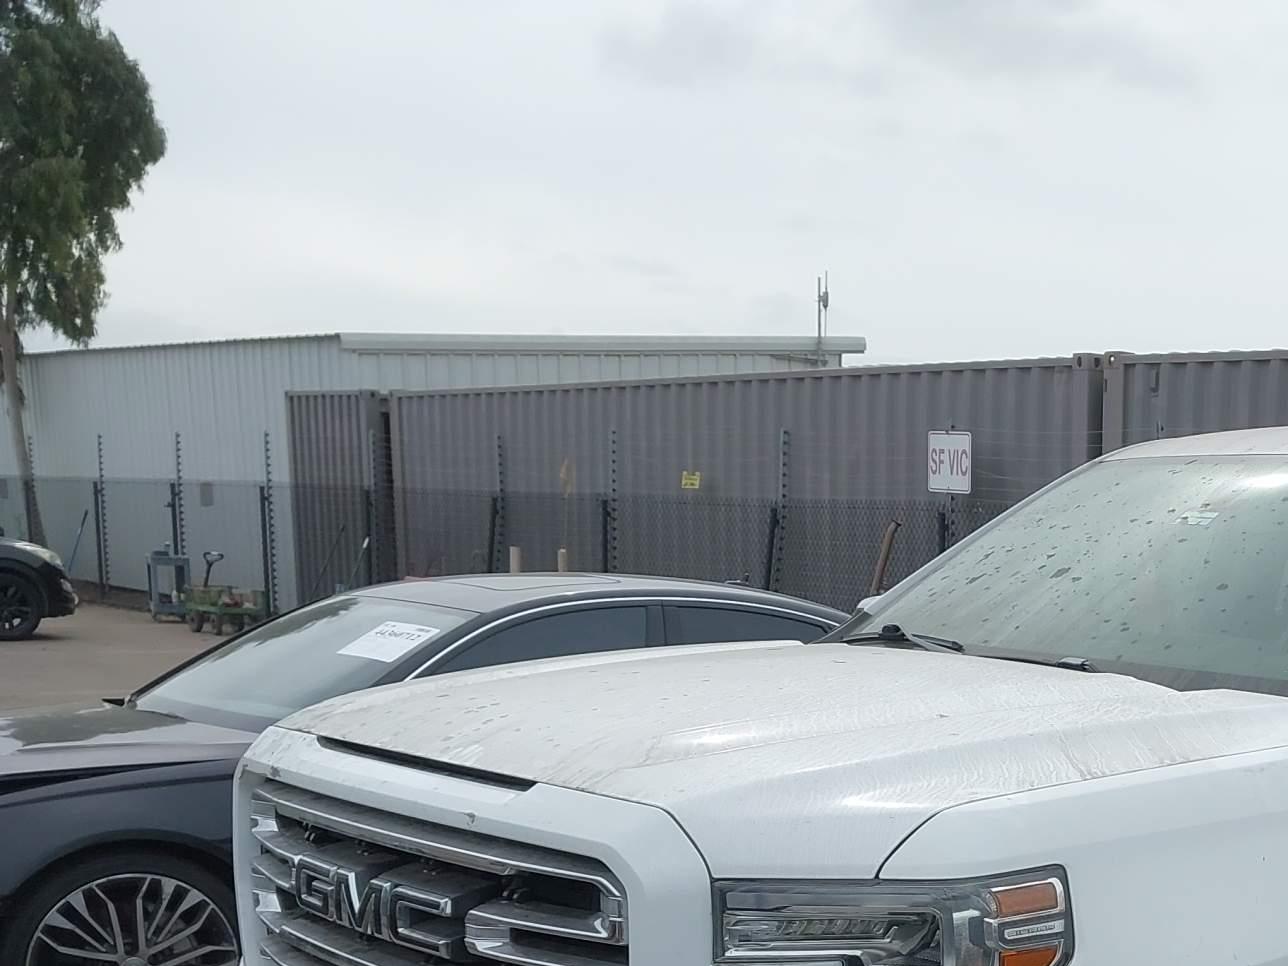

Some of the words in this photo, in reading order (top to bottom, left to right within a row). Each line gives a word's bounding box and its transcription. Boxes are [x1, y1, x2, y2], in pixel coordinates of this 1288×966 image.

[930, 448, 945, 475] SF
[948, 448, 968, 476] VIC
[295, 855, 451, 960] GMC
